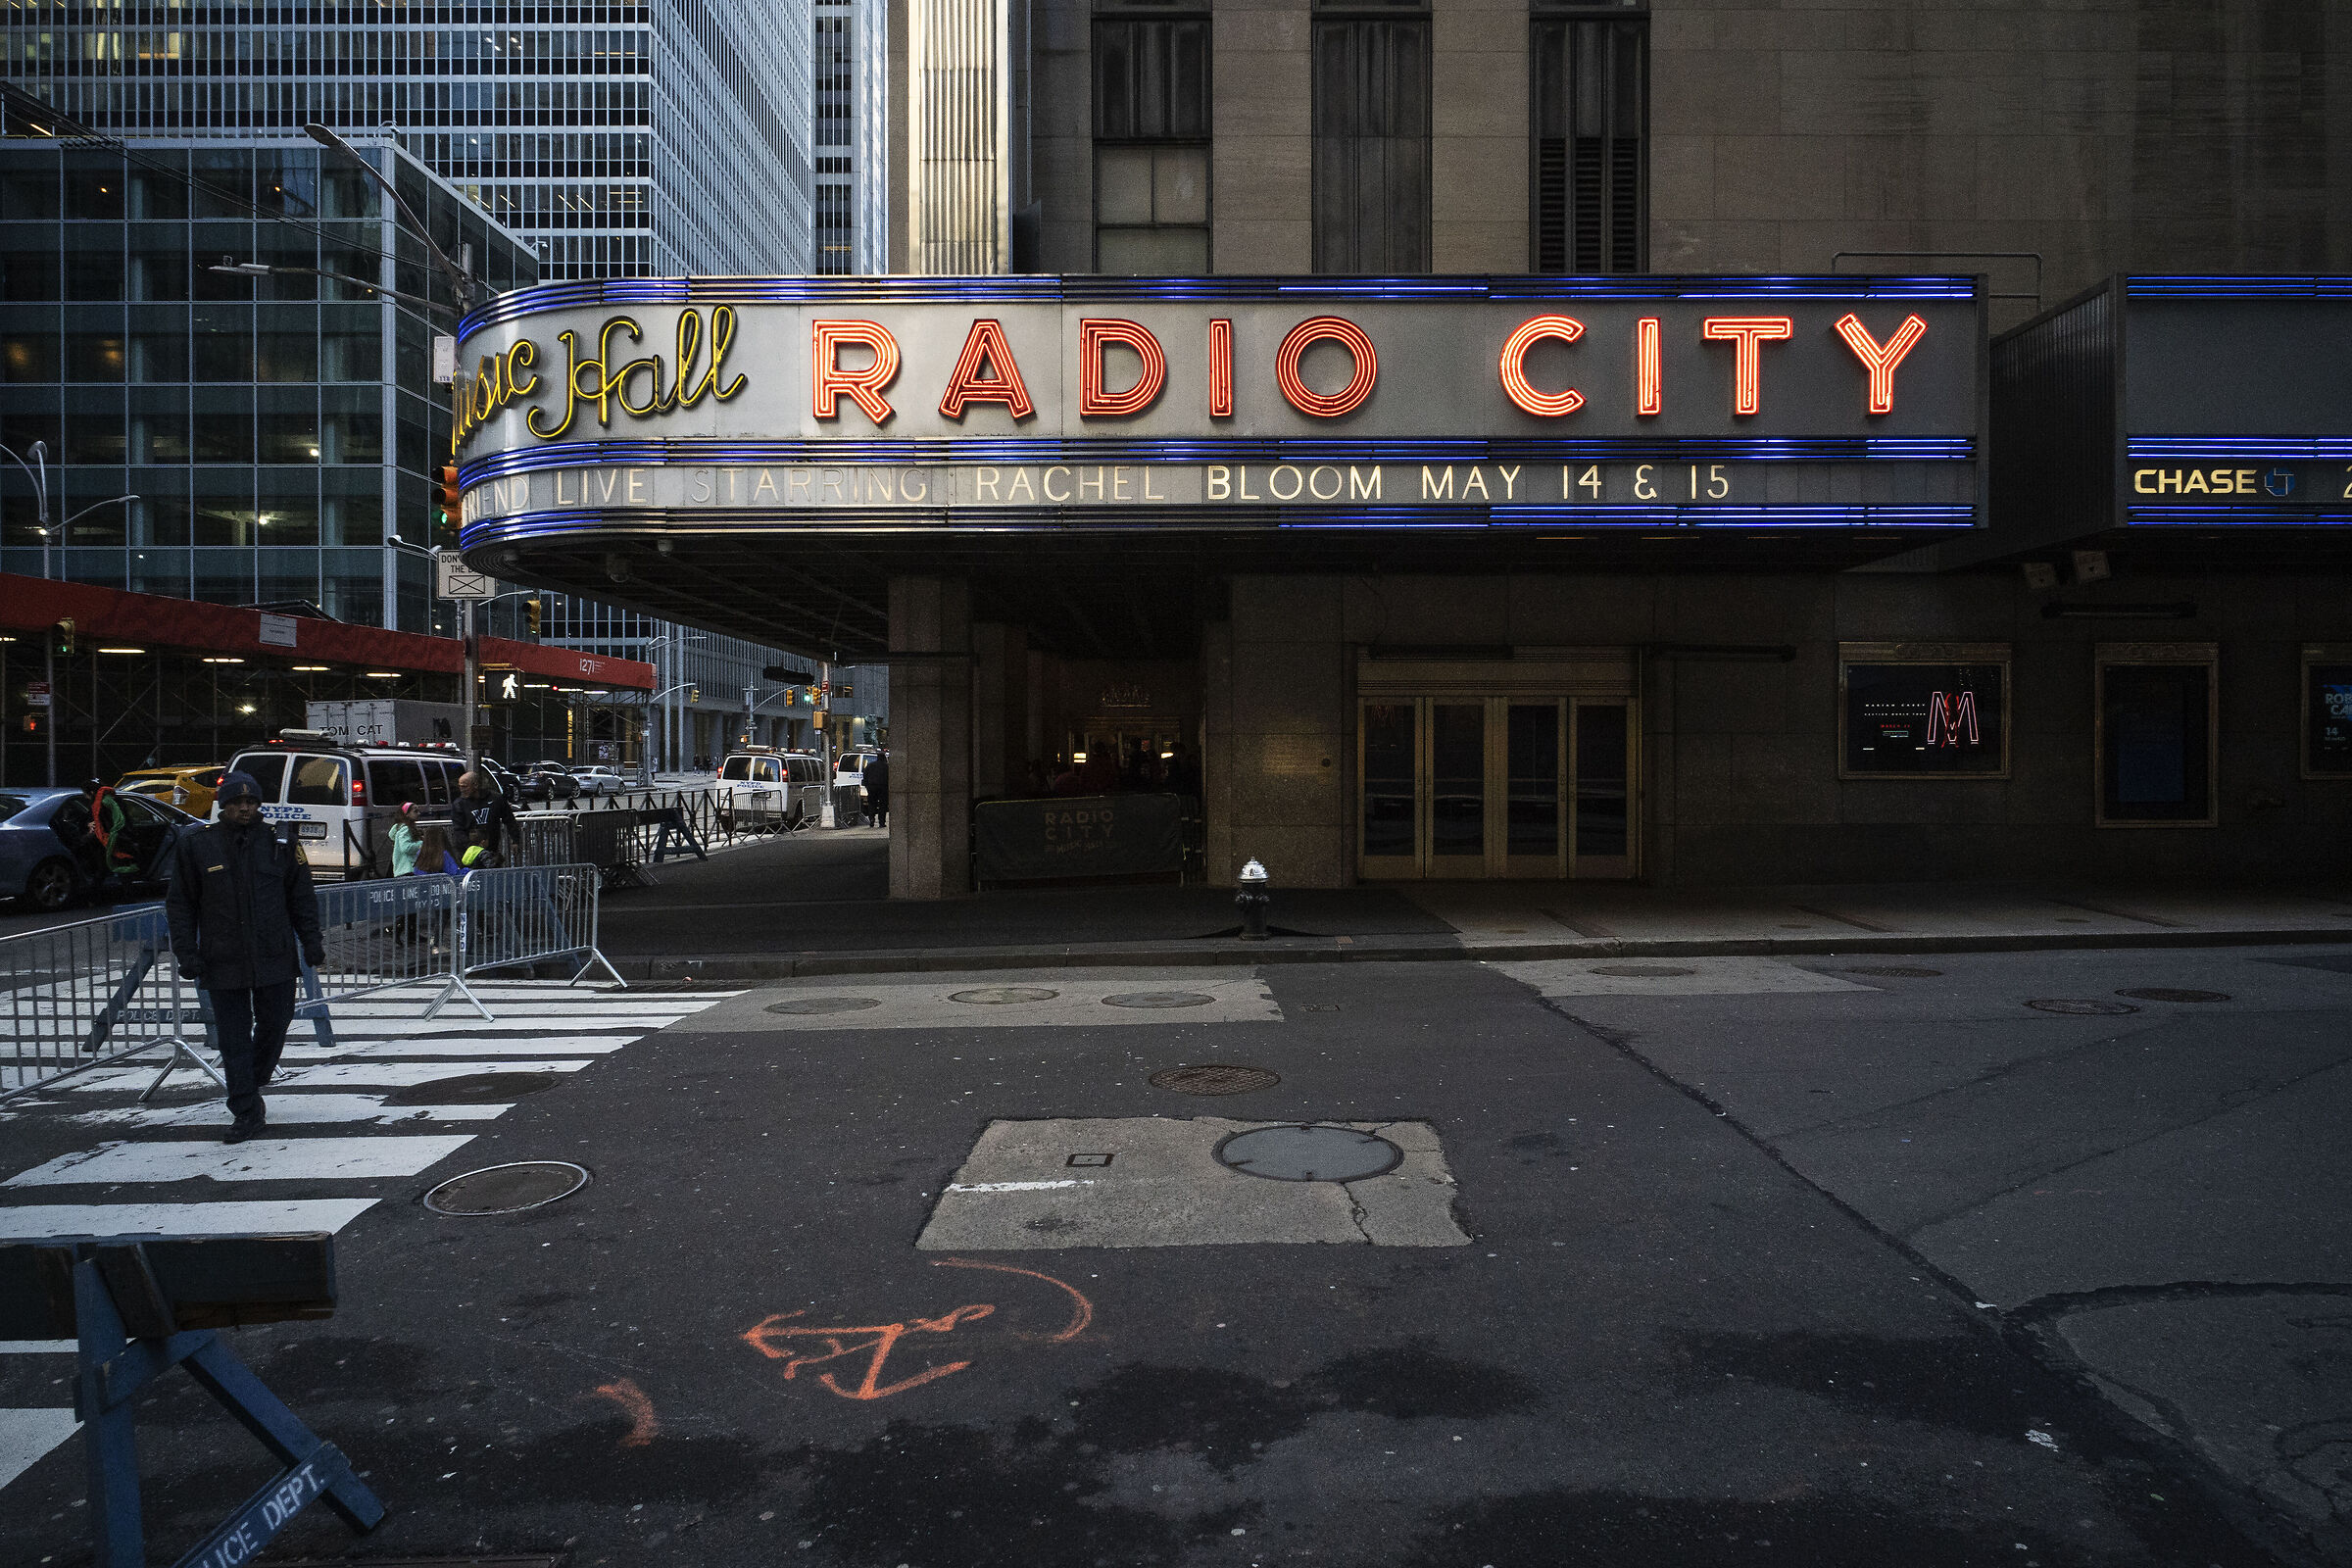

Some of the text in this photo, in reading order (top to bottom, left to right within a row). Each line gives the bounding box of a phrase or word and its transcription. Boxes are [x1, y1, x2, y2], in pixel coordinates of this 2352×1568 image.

[526, 302, 748, 439] Hall
[811, 313, 1929, 423] RADIO CITY
[557, 468, 647, 506] LIVE
[690, 466, 927, 504] STARRING
[977, 466, 1165, 501] RACHEL
[1207, 465, 1382, 500] BLOOM
[1422, 465, 1521, 500] MAY
[1562, 465, 1602, 500] 14
[1634, 465, 1657, 500] &
[1690, 465, 1730, 499] 15
[2133, 469, 2258, 494] CHASE
[451, 564, 466, 573] THE
[319, 724, 384, 736] TOM CAT
[263, 1464, 324, 1531] DEPT.
